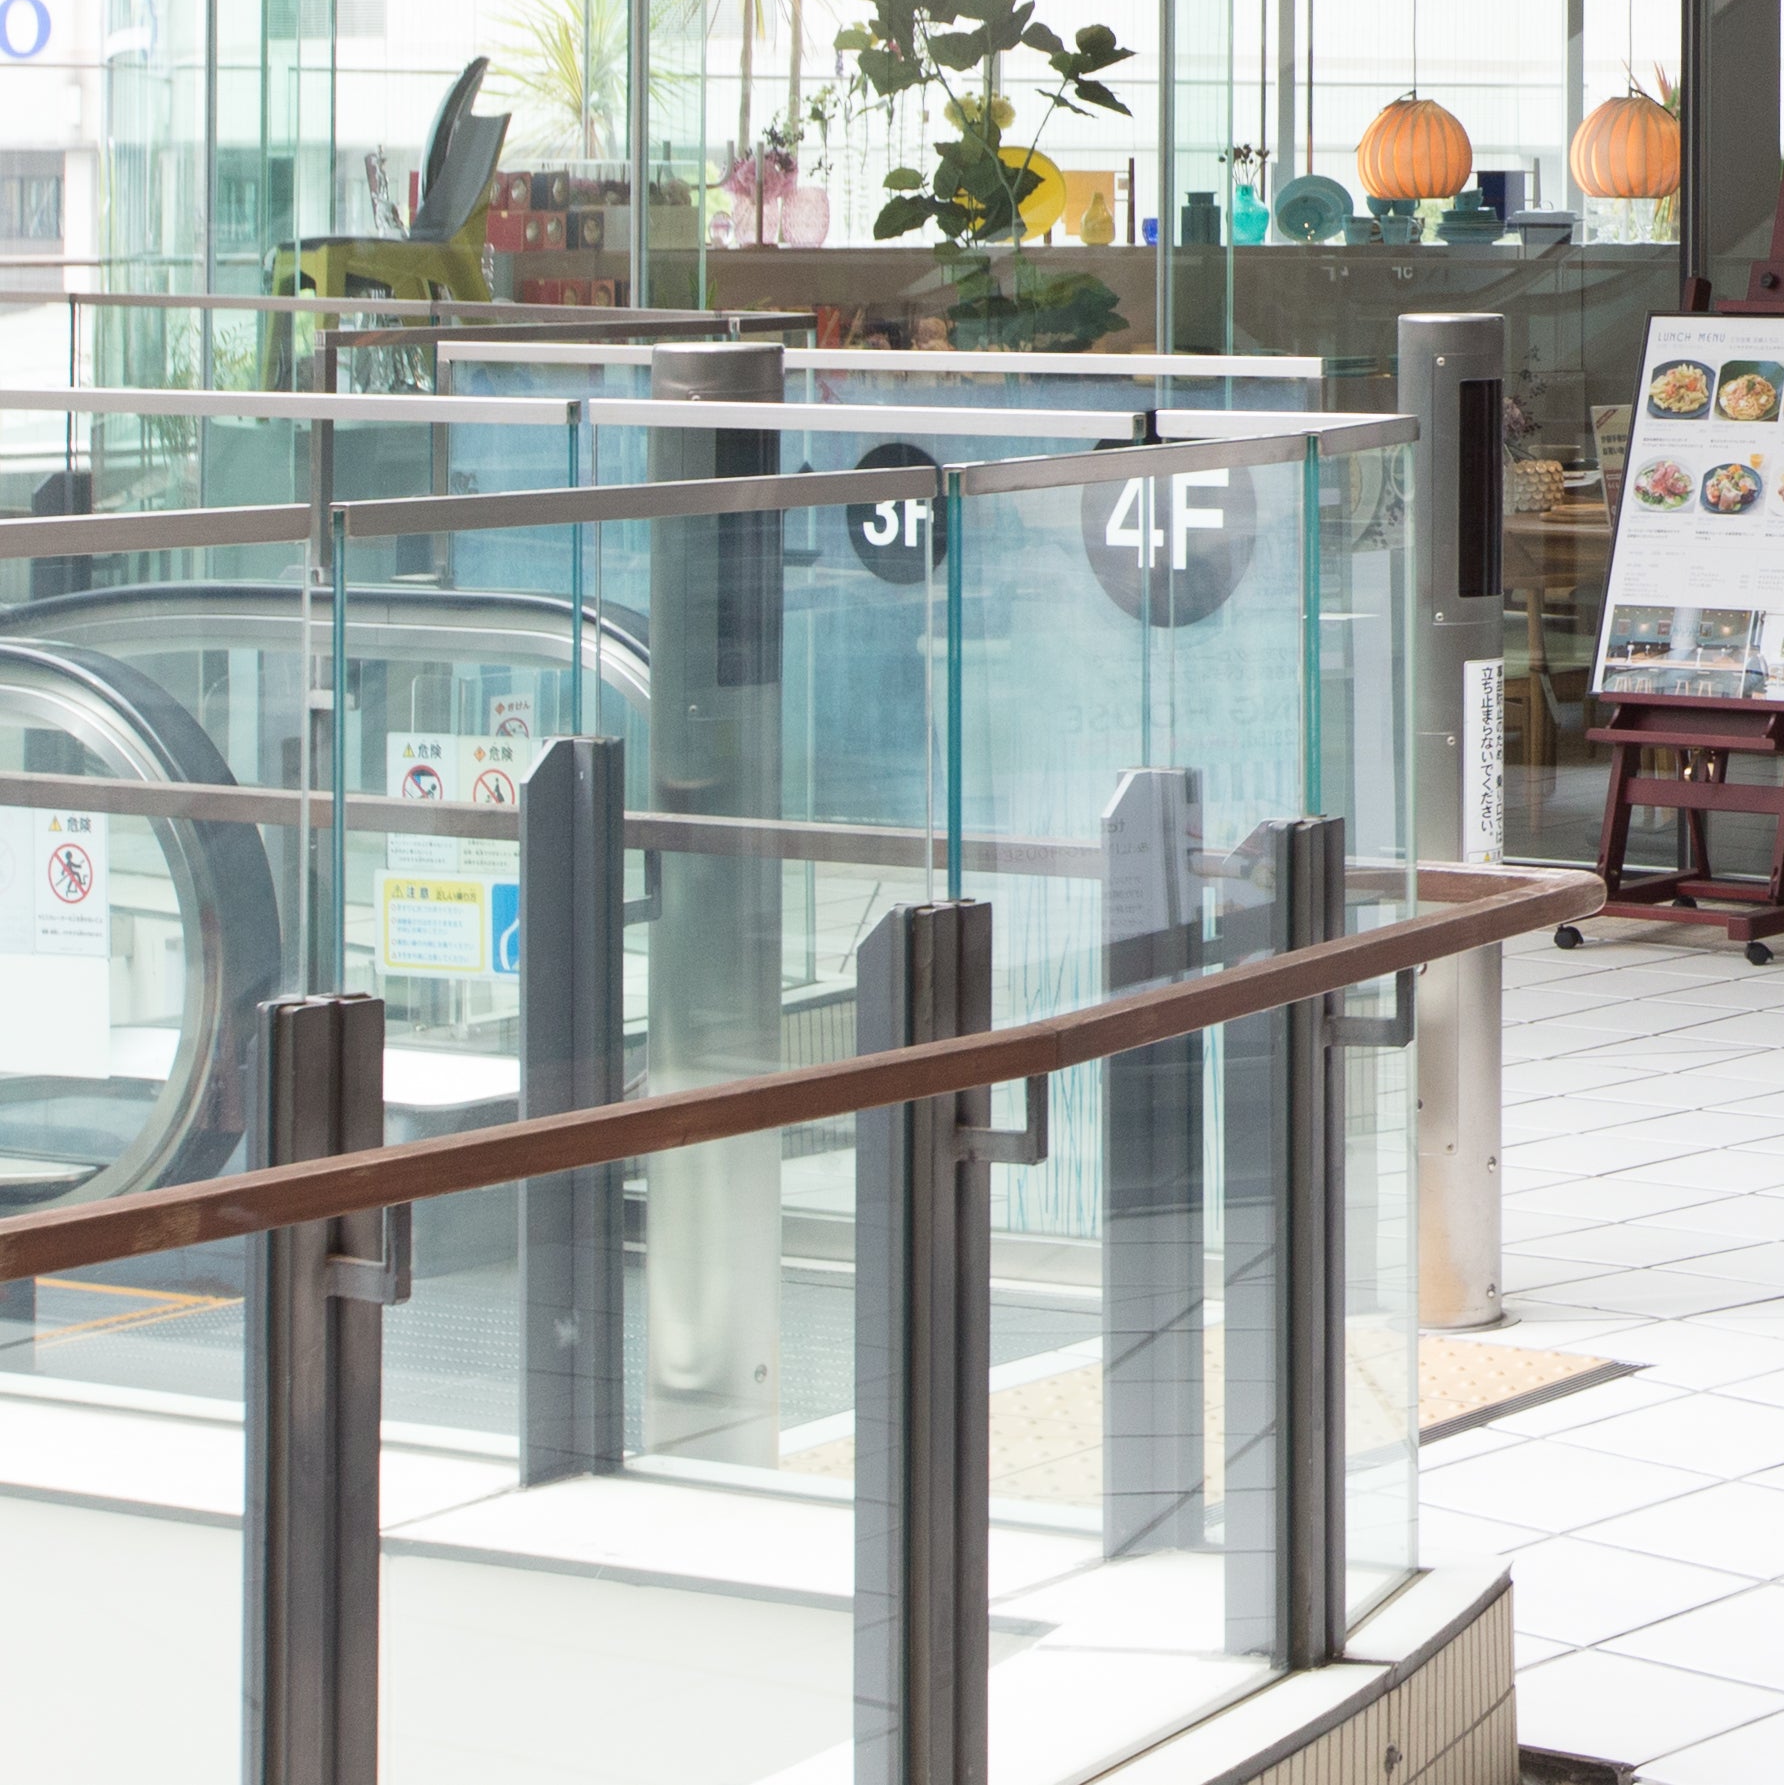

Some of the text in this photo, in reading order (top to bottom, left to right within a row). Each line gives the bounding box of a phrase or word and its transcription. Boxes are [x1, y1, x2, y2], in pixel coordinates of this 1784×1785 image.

[1657, 332, 1692, 343] LUNCH
[1699, 333, 1727, 344] MENU
[863, 498, 934, 547] 3F
[1106, 468, 1229, 570] 4F
[418, 743, 442, 759] 危険
[489, 745, 513, 762] 危険
[1480, 666, 1494, 836] 立ち止まらないでください。
[67, 817, 92, 833] 危険
